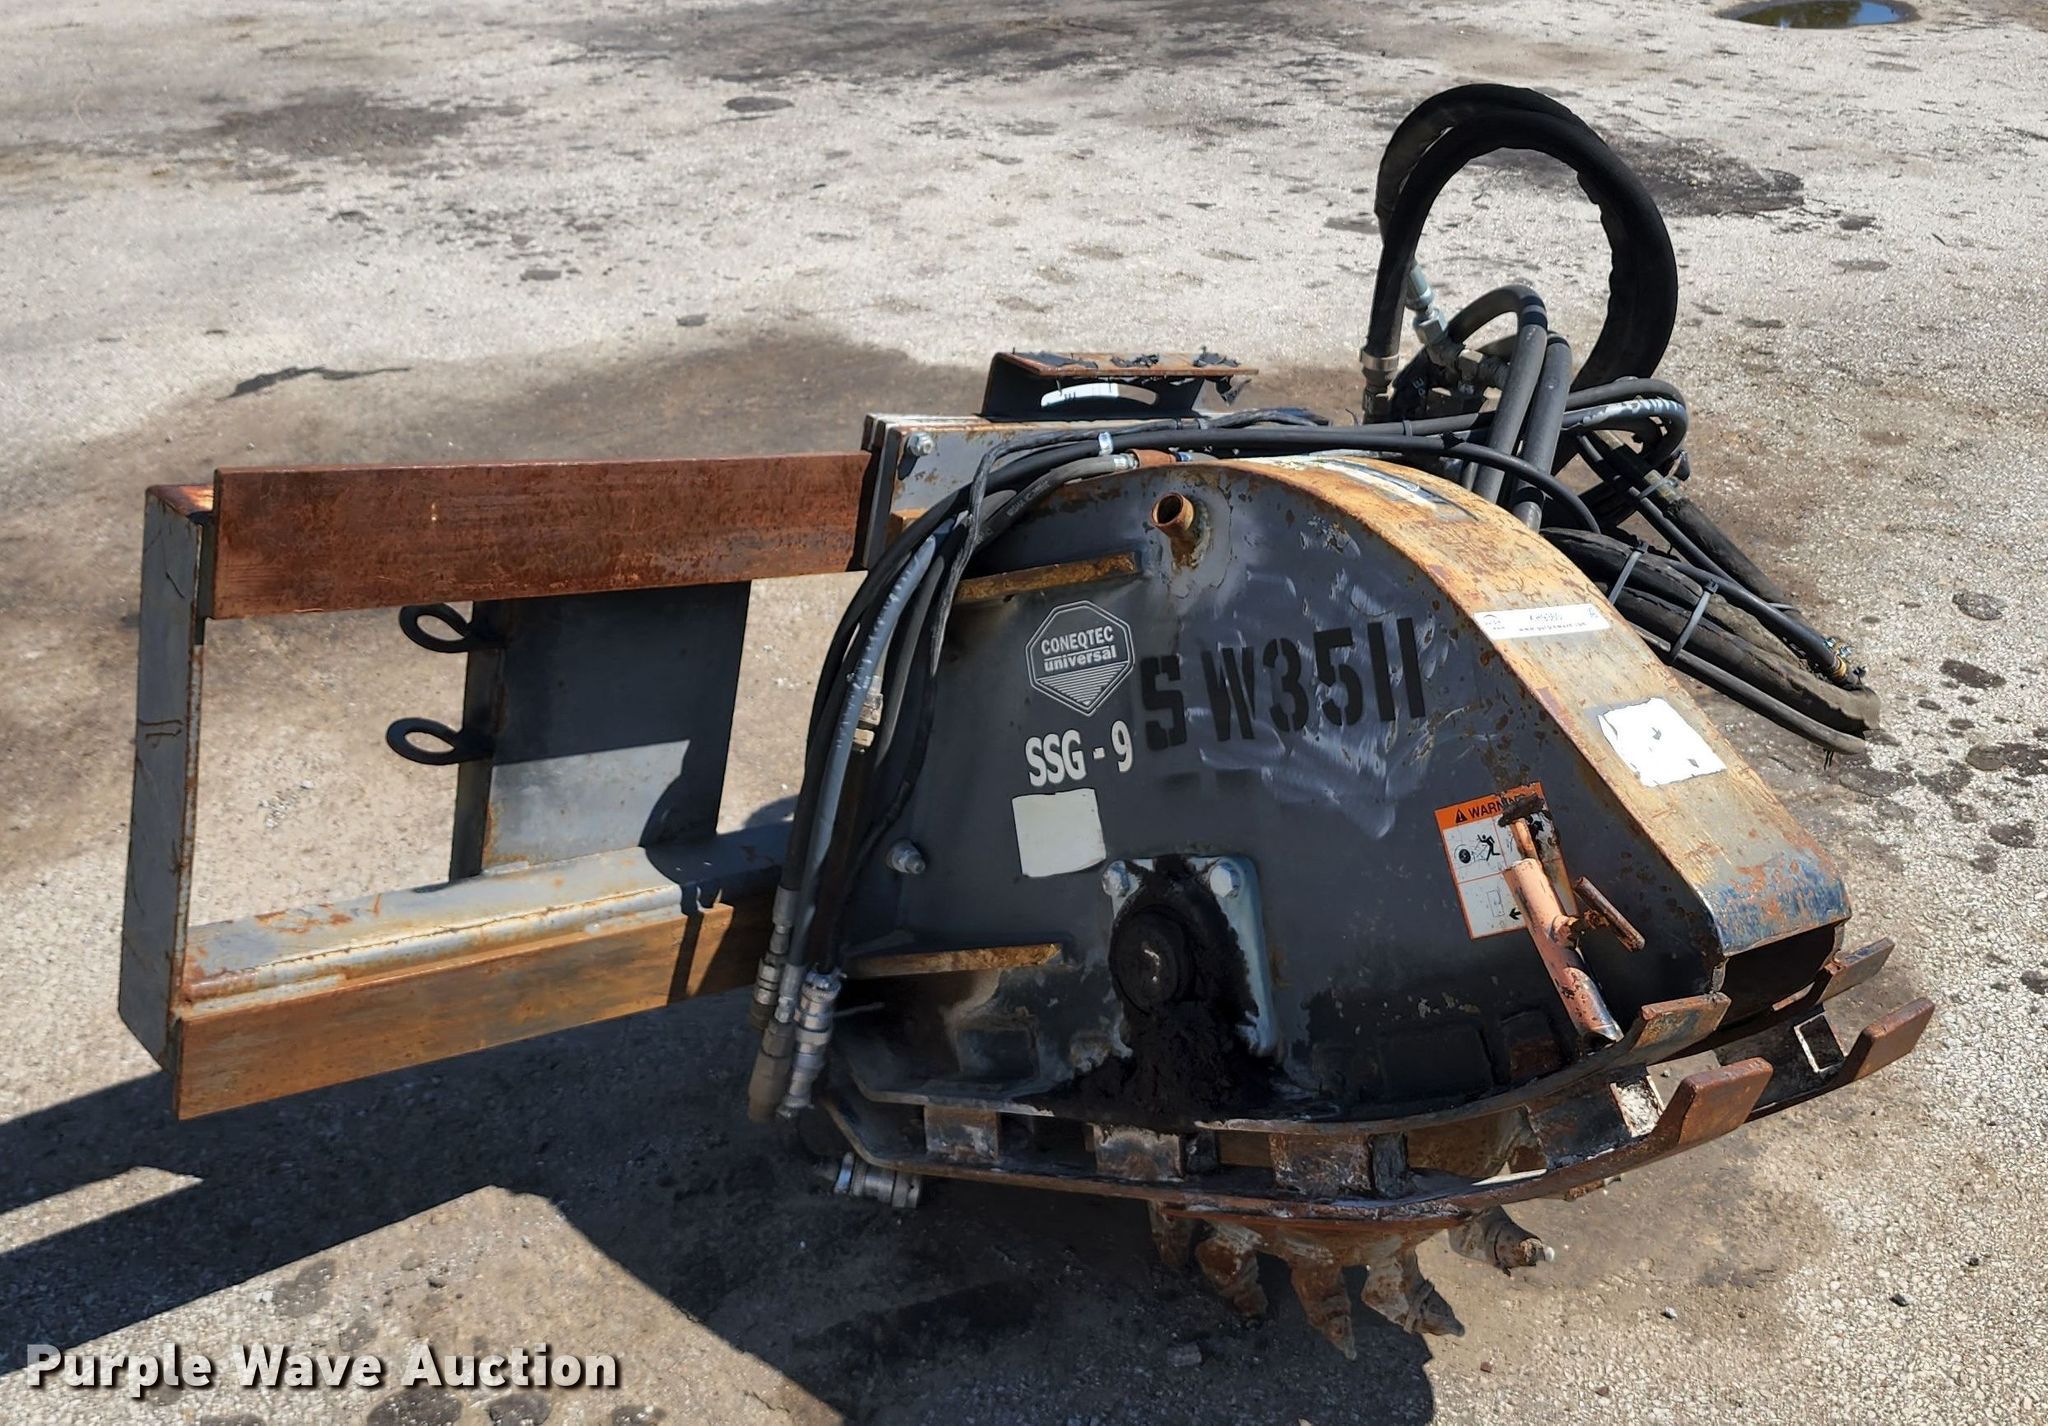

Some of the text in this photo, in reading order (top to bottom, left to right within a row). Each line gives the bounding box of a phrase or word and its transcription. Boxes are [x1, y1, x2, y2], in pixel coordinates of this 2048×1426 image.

[1041, 625, 1114, 655] CONEQTEC
[1043, 645, 1117, 672] universal
[1468, 793, 1527, 819] WARN
